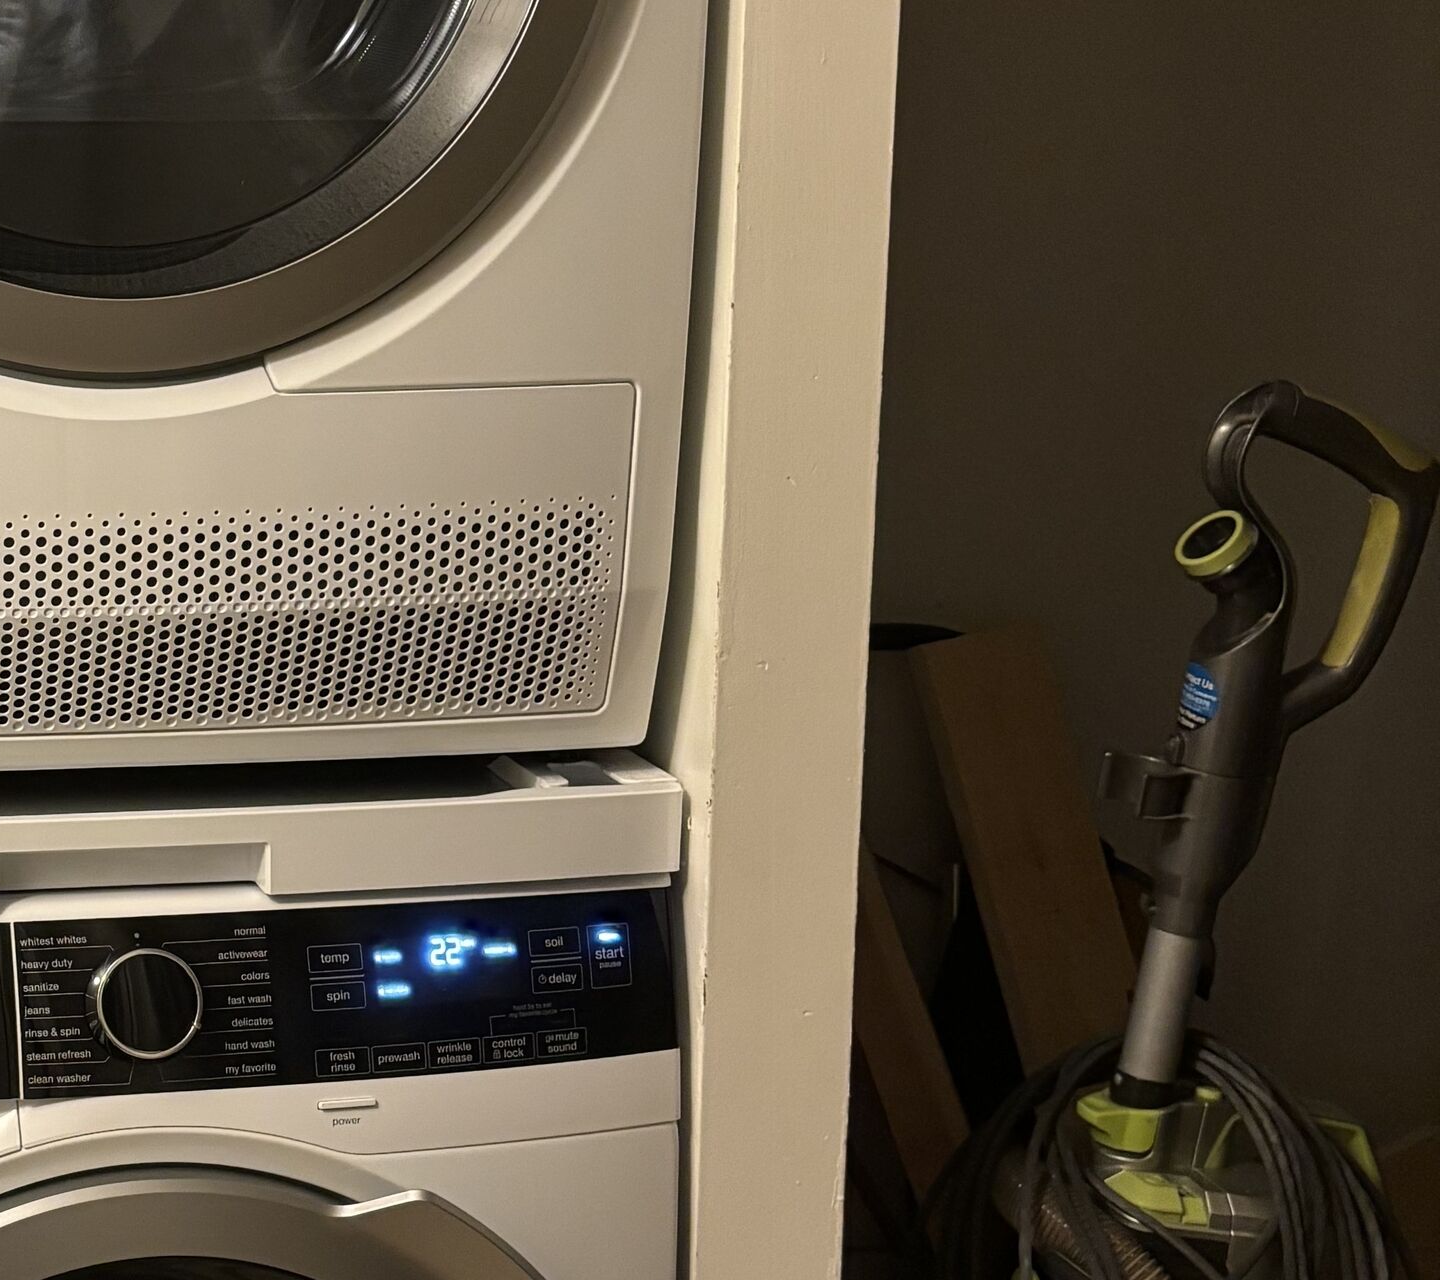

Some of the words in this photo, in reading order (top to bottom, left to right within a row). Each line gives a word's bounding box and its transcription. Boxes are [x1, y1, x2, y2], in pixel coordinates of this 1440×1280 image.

[234, 925, 266, 936] normal
[20, 936, 54, 947] whitest
[56, 934, 87, 945] whites
[545, 935, 564, 948] soil
[218, 949, 268, 961] activewear
[320, 951, 350, 965] temp
[595, 945, 625, 960] start
[21, 959, 49, 970] heavy
[51, 958, 73, 969] duty
[241, 971, 270, 981] colors
[549, 972, 577, 986] delay
[23, 982, 59, 992] sanitize
[227, 995, 246, 1005] fast
[247, 993, 272, 1004] wash
[326, 989, 351, 1003] spin
[24, 1006, 50, 1017] jeans
[231, 1016, 274, 1028] delicates
[25, 1027, 49, 1038] rinse
[51, 1027, 58, 1037] &
[60, 1026, 81, 1039] spin
[556, 1030, 579, 1042] mute
[225, 1040, 249, 1051] hand
[250, 1038, 275, 1049] wash
[437, 1041, 472, 1053] wrinkle
[492, 1036, 526, 1049] control
[548, 1040, 577, 1053] sound
[26, 1051, 56, 1061] steam
[58, 1049, 91, 1060] refresh
[330, 1050, 356, 1062] fresh
[378, 1050, 421, 1065] prewash
[437, 1051, 473, 1065] release
[503, 1047, 524, 1059] lock
[225, 1064, 240, 1075] my
[242, 1062, 277, 1074] favorite
[330, 1061, 356, 1072] rinse
[28, 1073, 54, 1084] clean
[56, 1072, 91, 1083] washer
[332, 1115, 361, 1128] power
